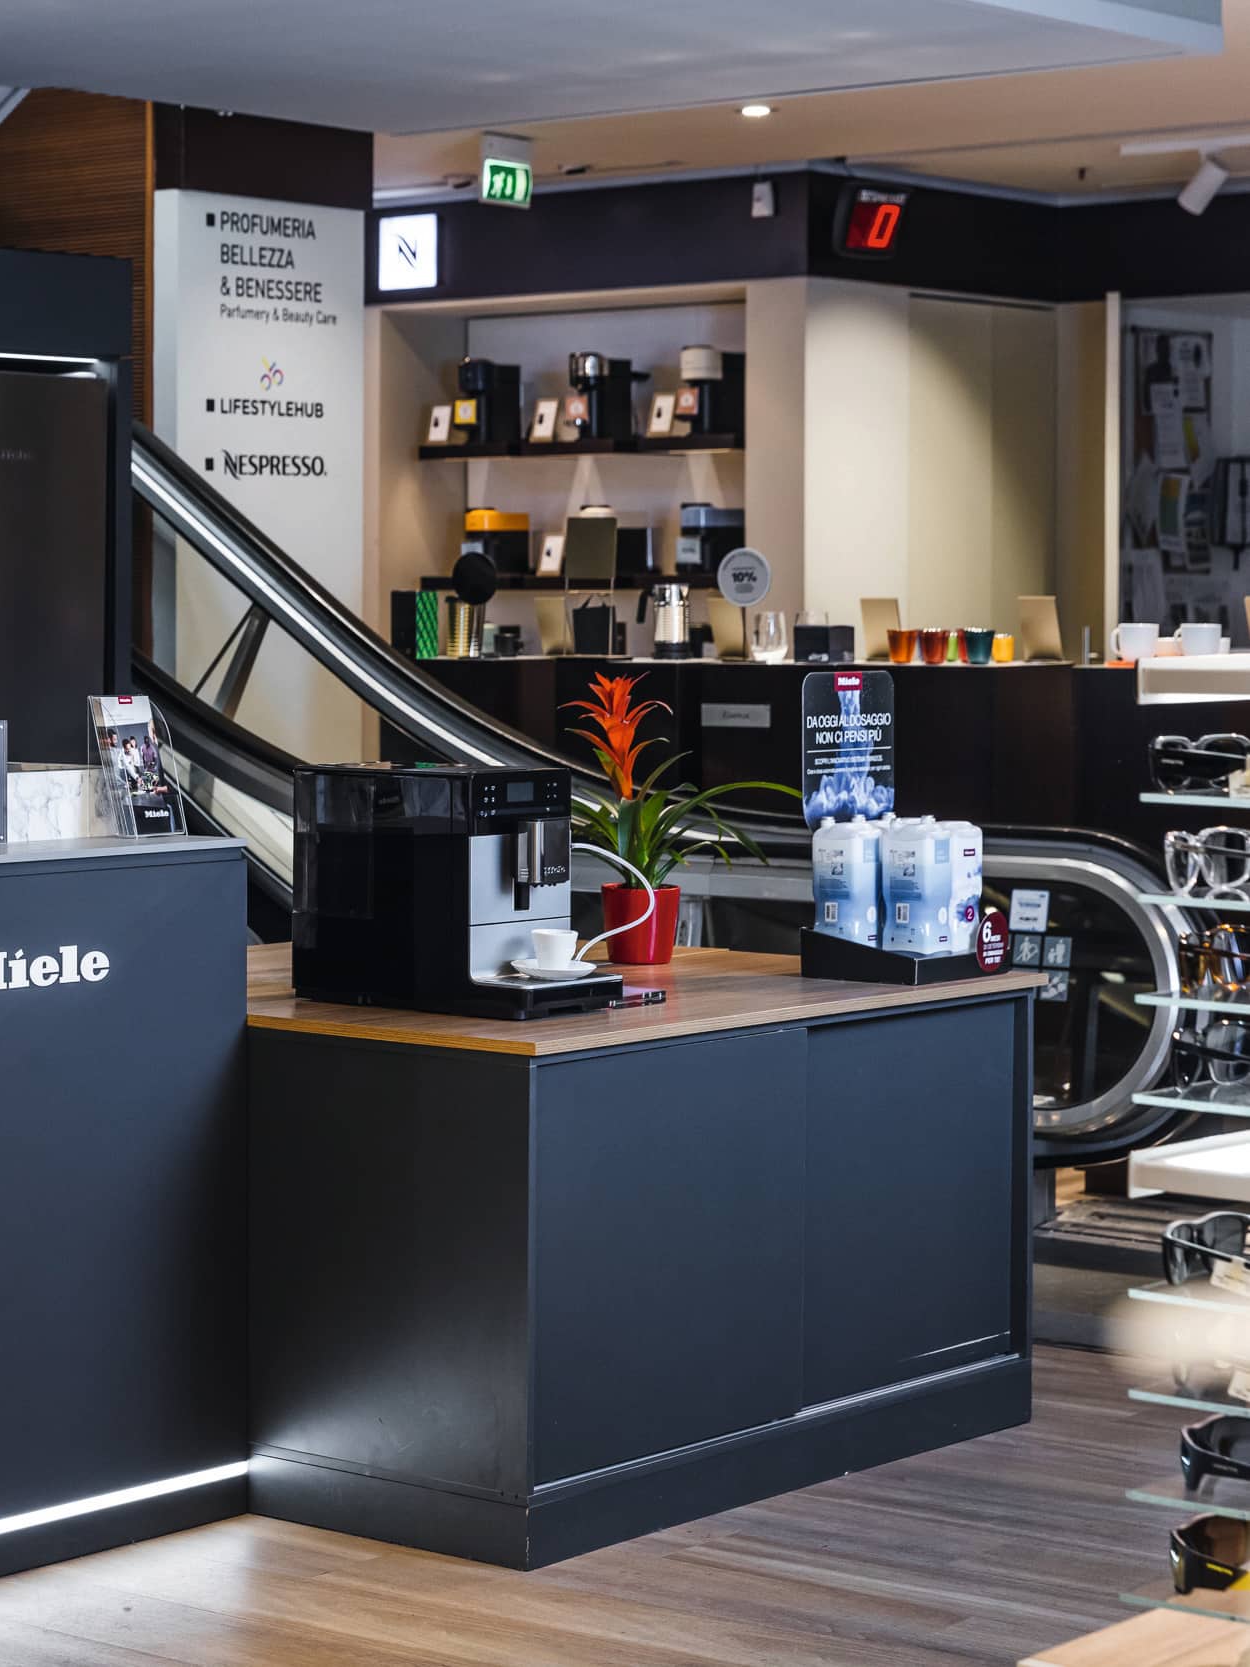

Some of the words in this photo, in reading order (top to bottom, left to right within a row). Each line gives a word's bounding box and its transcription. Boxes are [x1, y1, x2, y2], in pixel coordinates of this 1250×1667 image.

[220, 211, 316, 240] PROFUMERIA
[867, 203, 901, 249] 0
[220, 243, 295, 269] BELLEZZA
[220, 276, 230, 296] &
[235, 277, 323, 303] BENESSERE
[220, 303, 270, 325] Parfumery
[272, 308, 280, 321] &
[282, 308, 314, 327] Beauty
[316, 311, 338, 325] Care
[220, 398, 324, 418] LIFESTYLEHUB
[731, 571, 758, 583] 10%
[837, 677, 860, 686] Miele
[806, 716, 817, 729] DA
[818, 715, 838, 727] OGGI
[839, 714, 849, 727] AL
[849, 713, 891, 726] DOSAGGIO
[816, 731, 833, 744] NON
[835, 731, 843, 743] CI
[844, 730, 868, 742] PENSI
[868, 727, 882, 741] PIÙ
[144, 809, 169, 818] Miele
[967, 908, 973, 919] 2
[982, 921, 992, 943] 6
